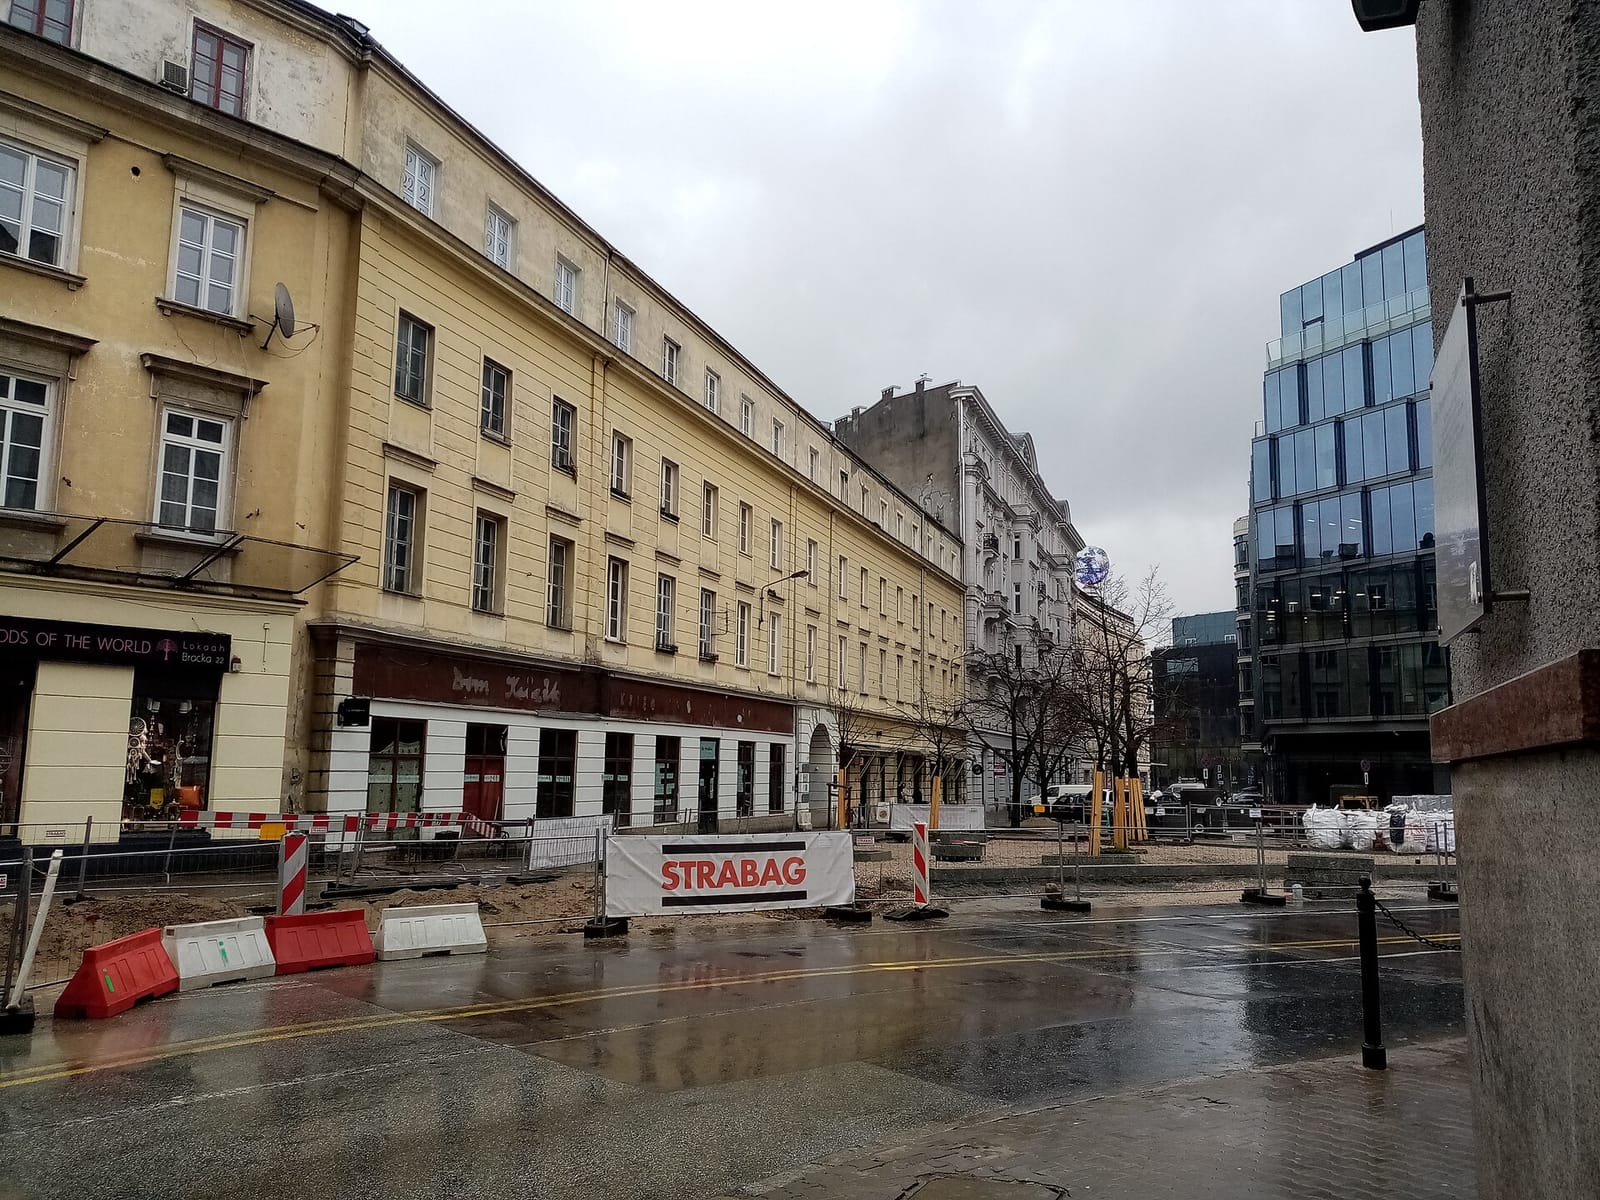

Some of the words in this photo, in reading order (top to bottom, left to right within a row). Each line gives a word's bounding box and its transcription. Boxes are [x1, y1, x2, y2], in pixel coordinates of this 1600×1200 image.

[36, 632, 57, 647] OF
[64, 634, 91, 650] THE
[97, 637, 151, 654] WORLD
[181, 652, 212, 664] Bracka
[215, 656, 225, 665] 22
[661, 856, 807, 891] STRABAG
